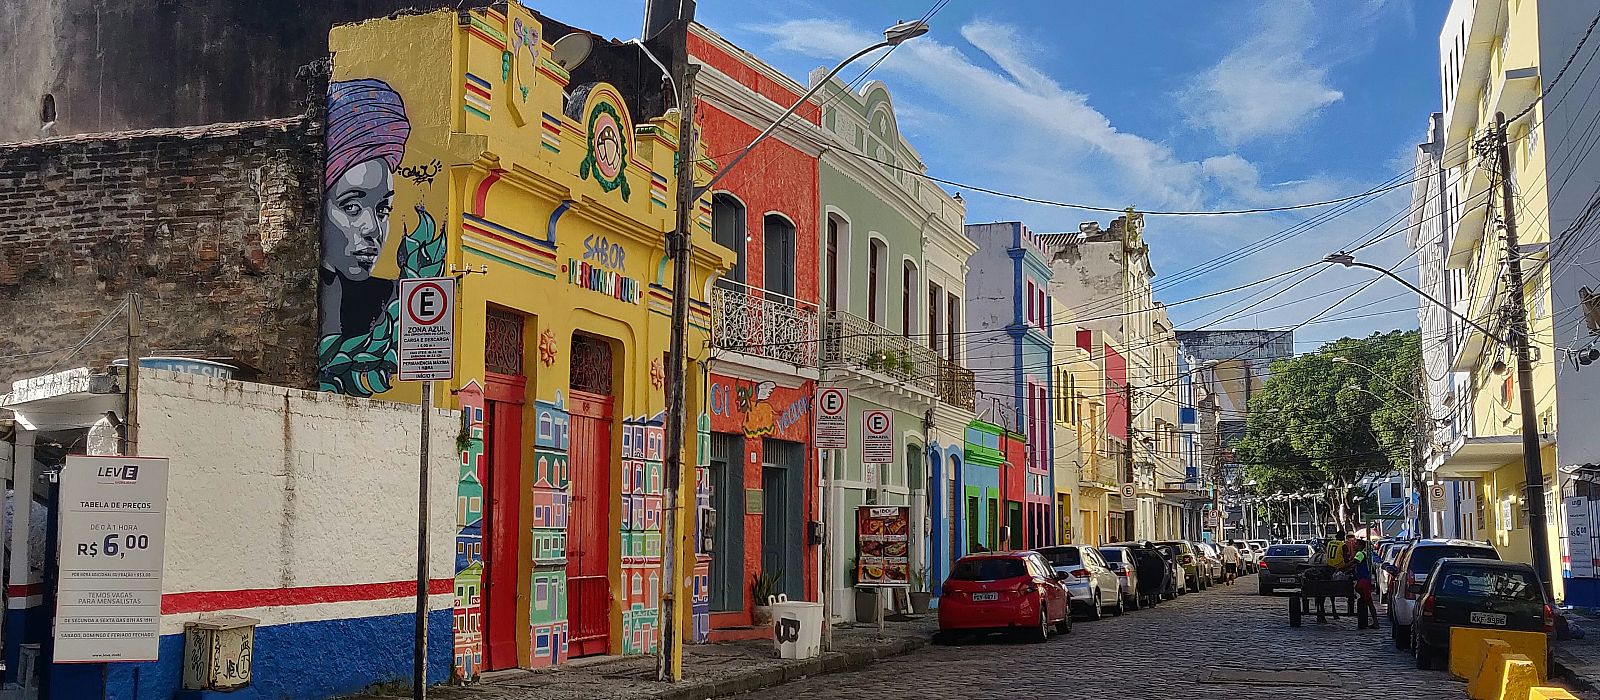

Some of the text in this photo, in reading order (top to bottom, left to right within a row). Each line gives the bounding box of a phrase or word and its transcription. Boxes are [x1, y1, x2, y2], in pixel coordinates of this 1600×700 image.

[582, 233, 626, 273] SABOR
[568, 257, 640, 305] PERNAMBUCO
[407, 325, 446, 334] ZONA AZUL
[873, 416, 883, 430] E
[97, 465, 138, 480] LEVE
[1434, 488, 1441, 496] E
[80, 501, 152, 511] TABELA DE PREÇOS
[77, 533, 149, 560] R$ 6,00
[1328, 543, 1338, 559] 10
